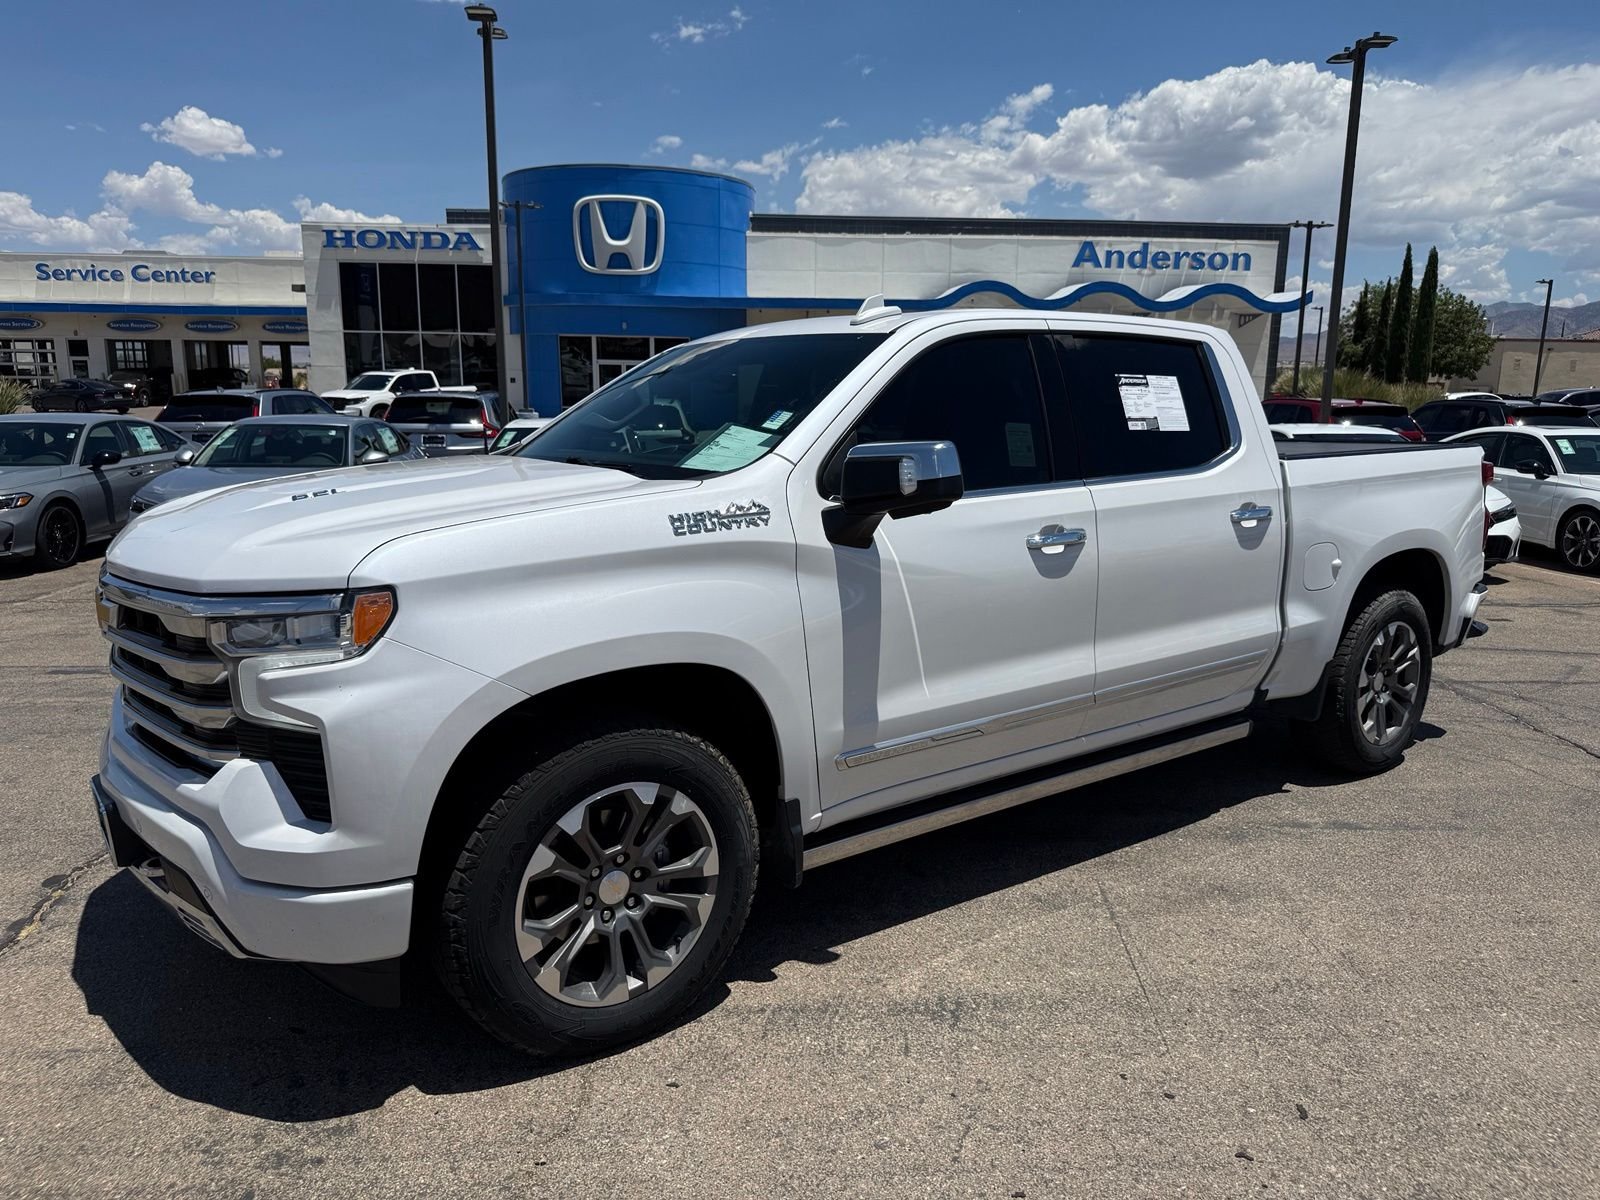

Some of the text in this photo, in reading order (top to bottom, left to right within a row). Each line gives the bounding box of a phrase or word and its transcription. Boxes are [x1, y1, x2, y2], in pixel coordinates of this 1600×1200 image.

[322, 229, 484, 251] HONDA
[1071, 240, 1252, 271] Anderson
[35, 262, 216, 284] Service Center
[667, 509, 721, 525] HIGH
[672, 515, 771, 537] COUNTRY
